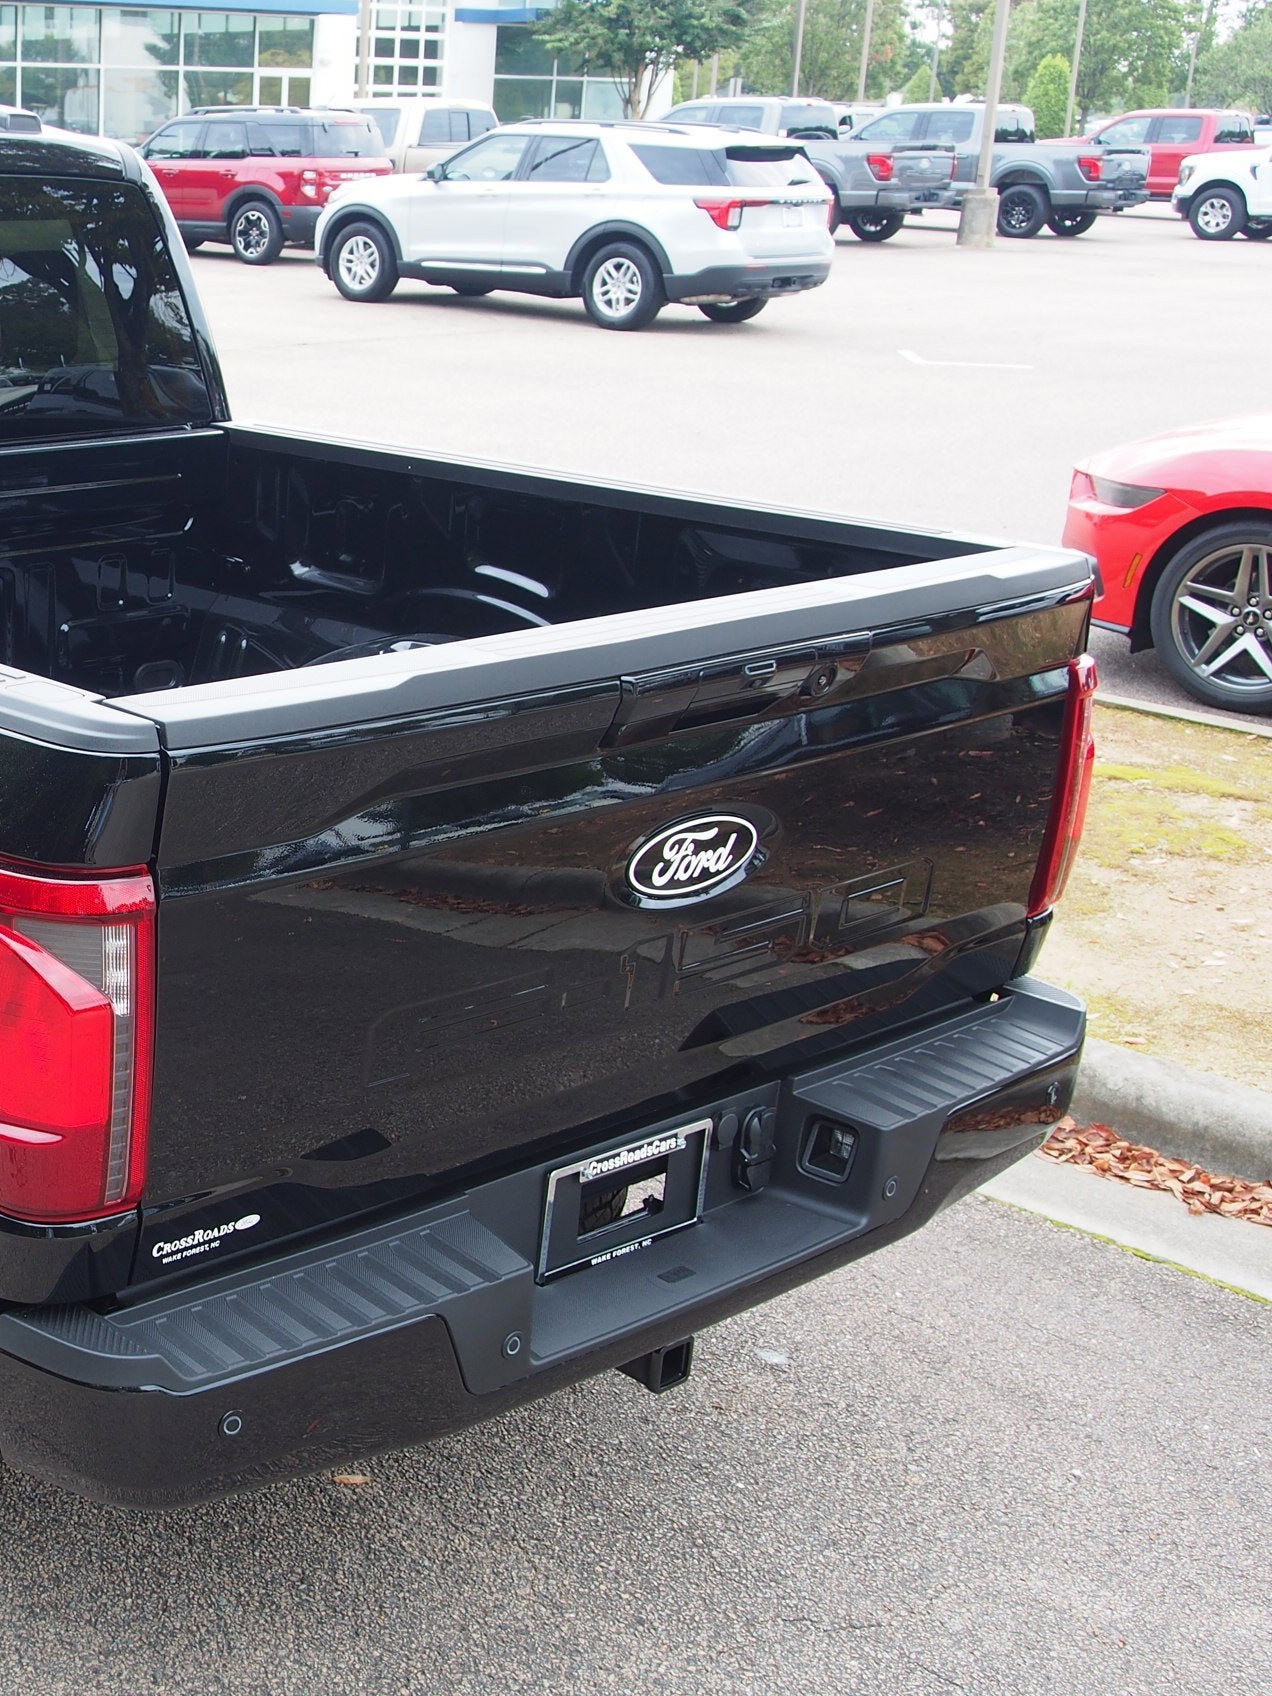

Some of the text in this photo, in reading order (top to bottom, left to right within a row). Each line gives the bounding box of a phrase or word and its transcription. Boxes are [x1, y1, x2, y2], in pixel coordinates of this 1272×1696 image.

[651, 826, 738, 887] Ford
[162, 1240, 221, 1265] WAKE FOREST, NC
[590, 1238, 653, 1266] WAKE FOREST, NC
